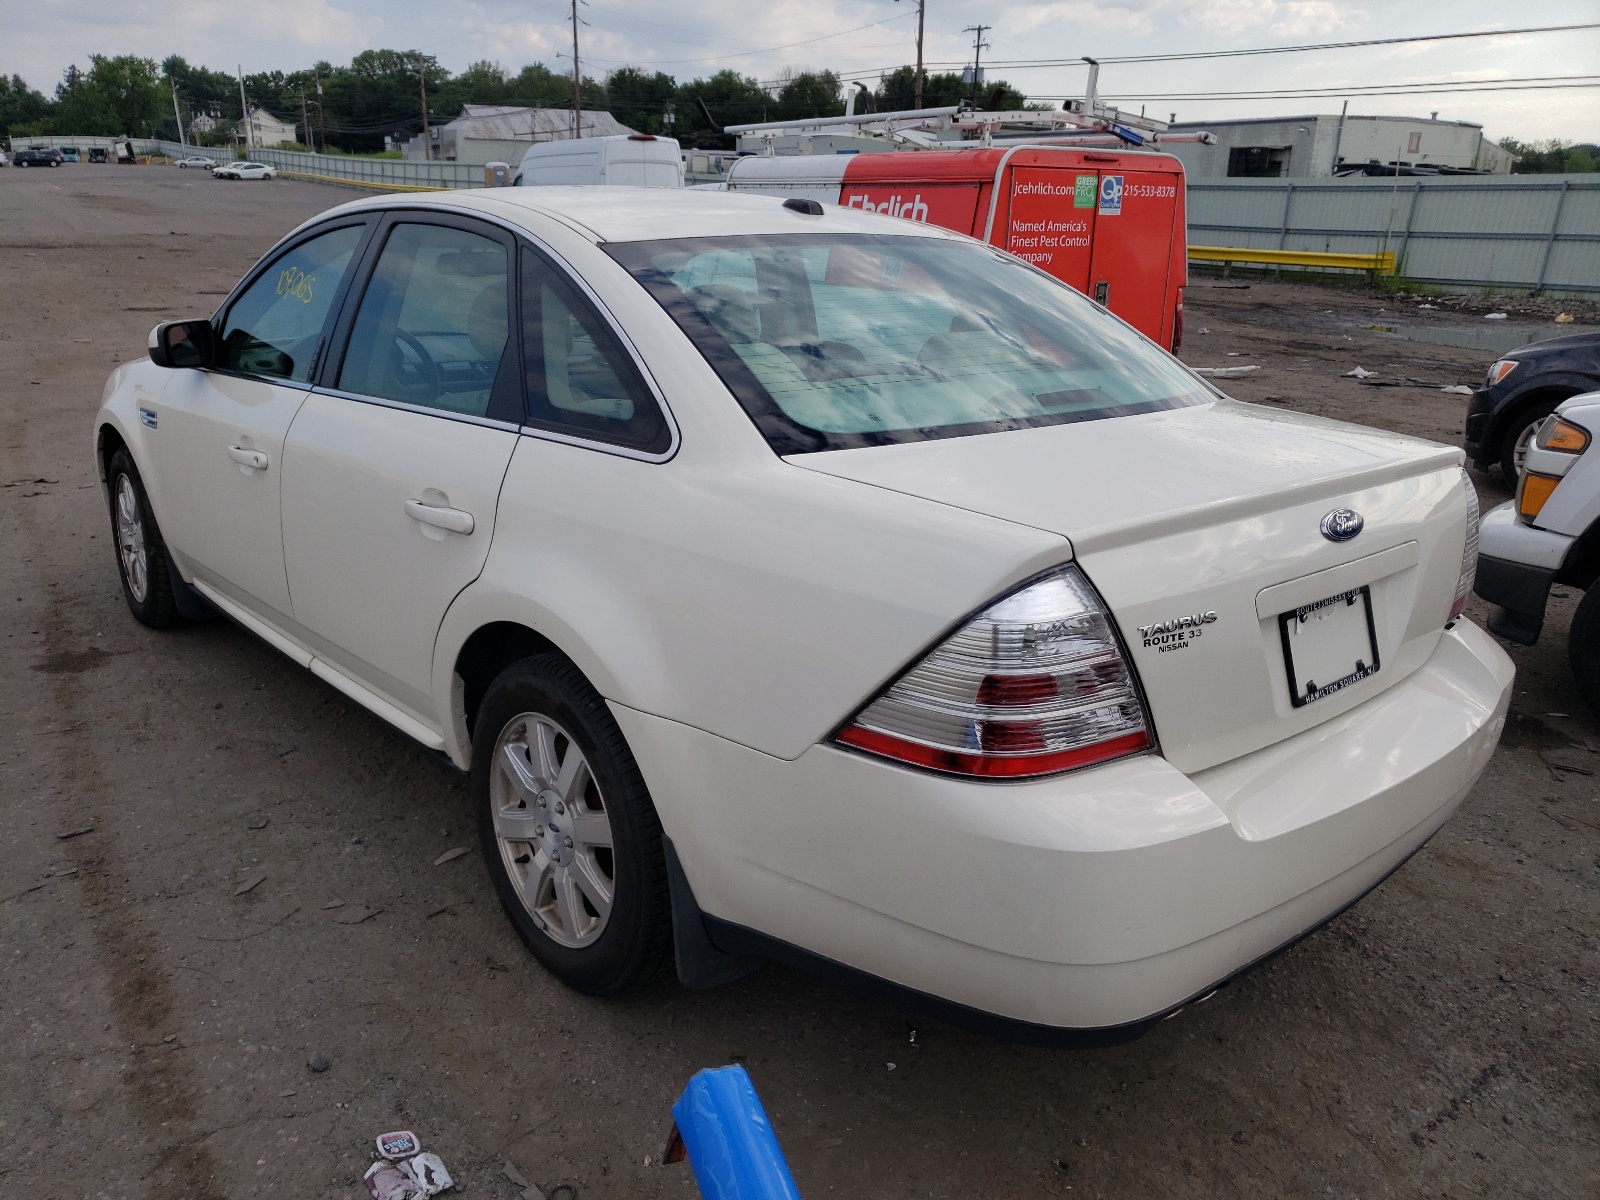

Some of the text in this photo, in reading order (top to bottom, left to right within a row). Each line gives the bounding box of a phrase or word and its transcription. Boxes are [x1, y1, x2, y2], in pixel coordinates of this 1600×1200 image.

[1076, 176, 1098, 186] GREEN
[1013, 181, 1075, 197] jcehrlich.com
[1075, 185, 1094, 197] PRO
[1123, 184, 1175, 198] 215-533-8378
[1012, 219, 1087, 232] Named America's
[1011, 234, 1090, 247] Finest Pest Control
[1136, 610, 1218, 639] TAURUS
[1143, 628, 1203, 647] ROUTE 33
[1158, 641, 1189, 653] NISSAN
[1305, 683, 1338, 704] HAMILTON
